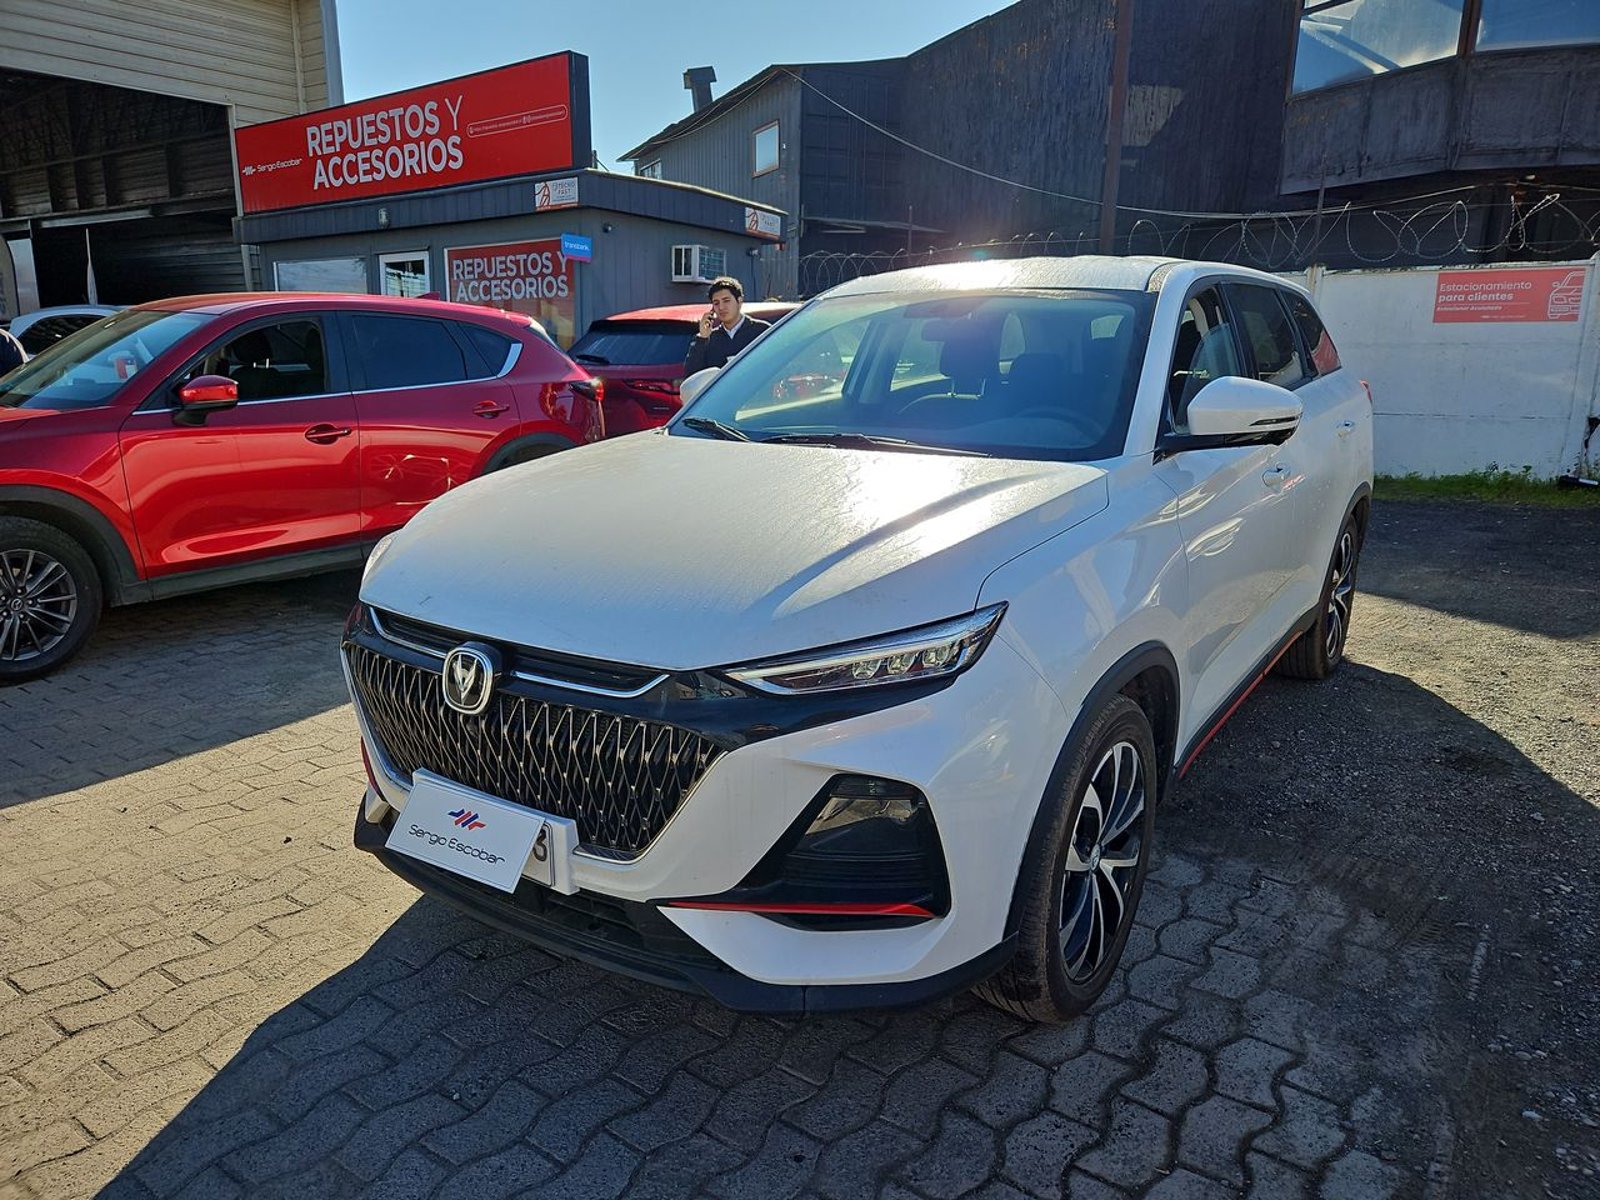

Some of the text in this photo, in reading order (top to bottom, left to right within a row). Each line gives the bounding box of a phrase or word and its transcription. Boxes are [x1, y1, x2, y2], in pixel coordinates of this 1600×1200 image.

[306, 101, 440, 157] REPUESTOS
[445, 95, 463, 131] Y
[313, 135, 464, 190] ACCESORIOS
[453, 250, 567, 280] REPUESTOS Y
[456, 275, 569, 302] ACCESORIOS
[1438, 291, 1515, 303] para clientes
[1440, 281, 1532, 292] Estacionamiento
[408, 824, 506, 864] Sergo Escobar
